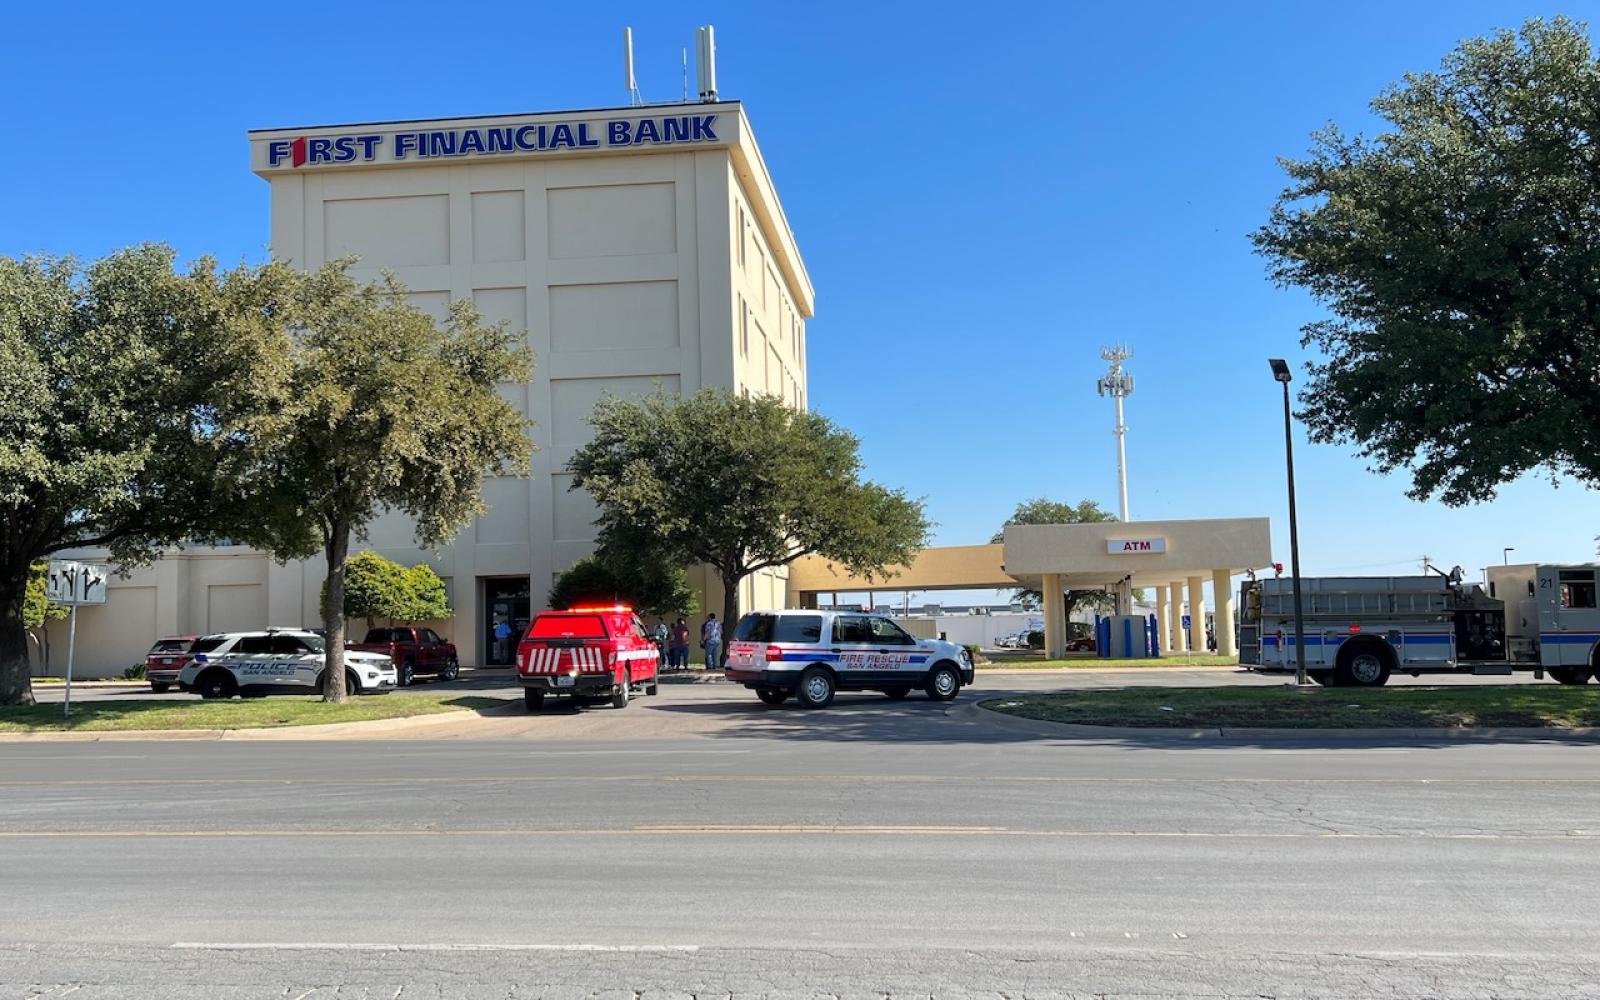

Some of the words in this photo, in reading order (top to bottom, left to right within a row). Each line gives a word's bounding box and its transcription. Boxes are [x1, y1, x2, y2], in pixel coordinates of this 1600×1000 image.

[394, 122, 600, 159] FINANCIAL
[607, 113, 718, 146] BANK
[1123, 541, 1151, 551] ATM
[1540, 578, 1552, 589] 21
[840, 654, 864, 663] FIRE
[867, 655, 910, 664] RESCUE
[847, 662, 865, 670] SAN
